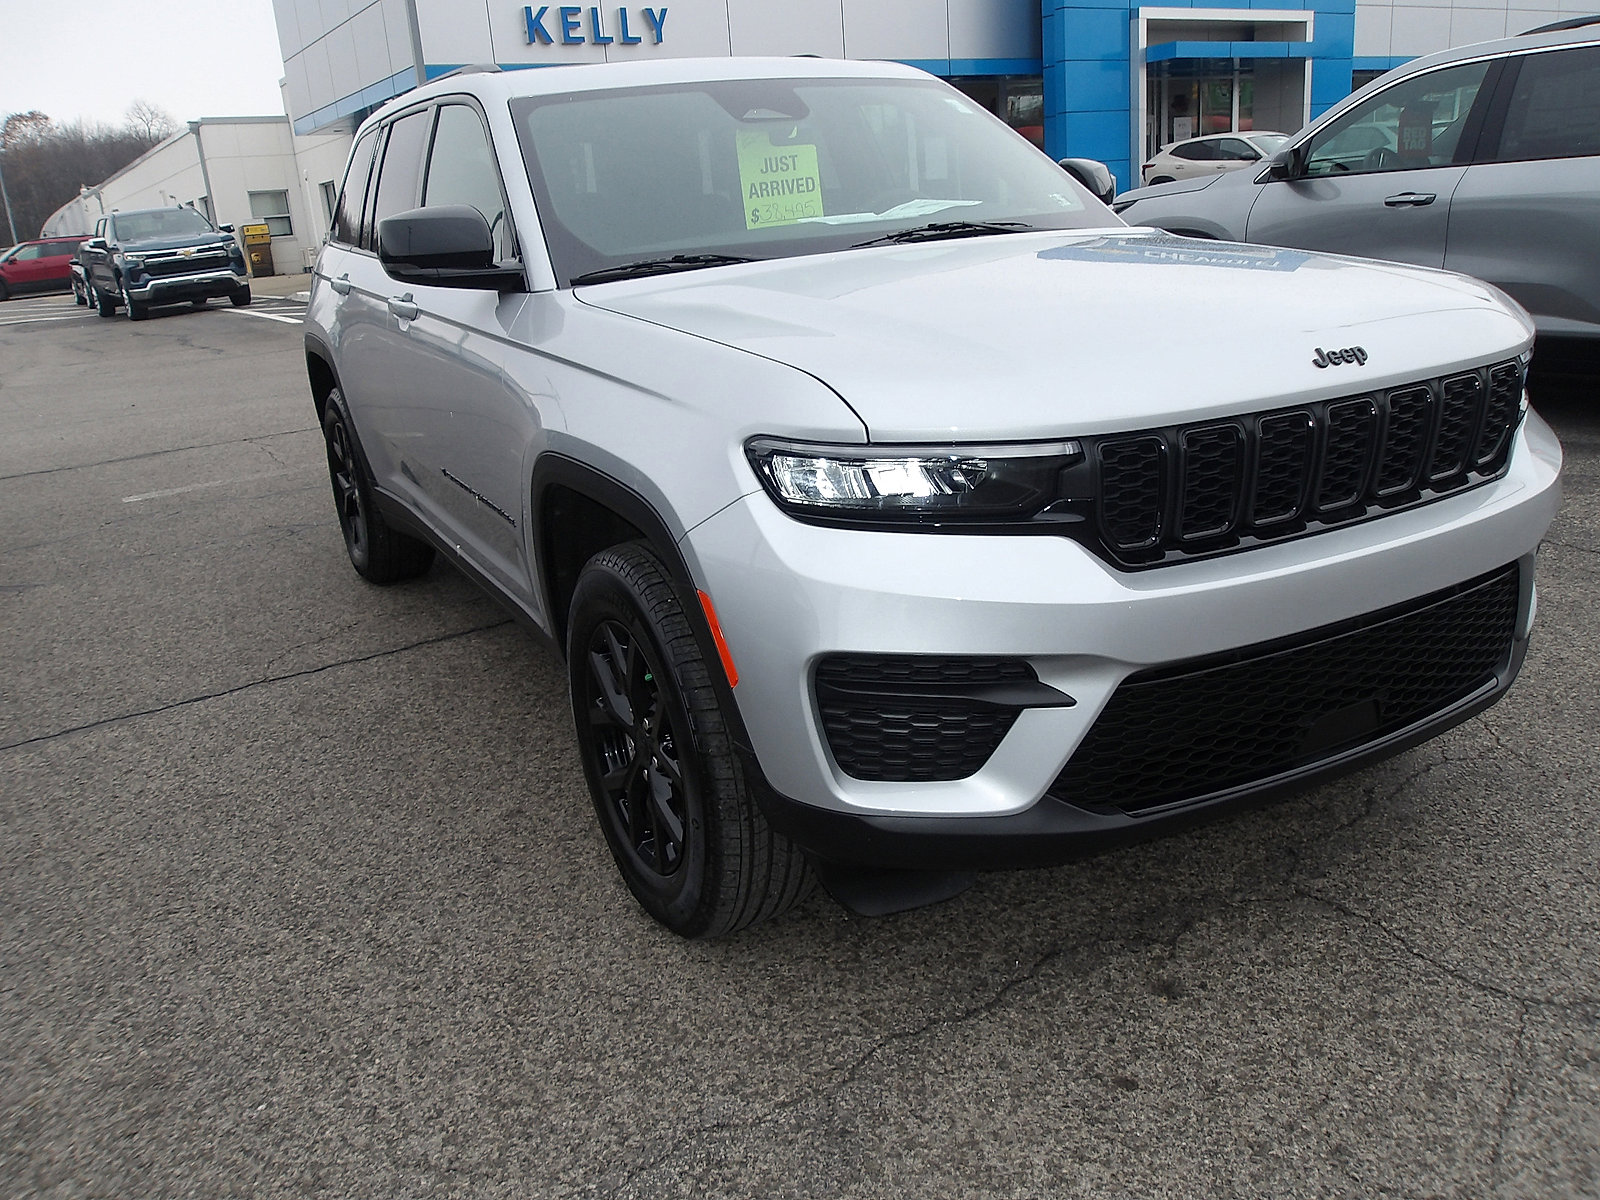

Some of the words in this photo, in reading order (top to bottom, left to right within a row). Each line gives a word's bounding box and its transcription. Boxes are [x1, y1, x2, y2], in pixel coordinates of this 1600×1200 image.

[522, 6, 669, 45] KELLY
[760, 154, 798, 174] JUST
[748, 176, 816, 200] ARRIVED
[1311, 345, 1369, 369] Jeep
